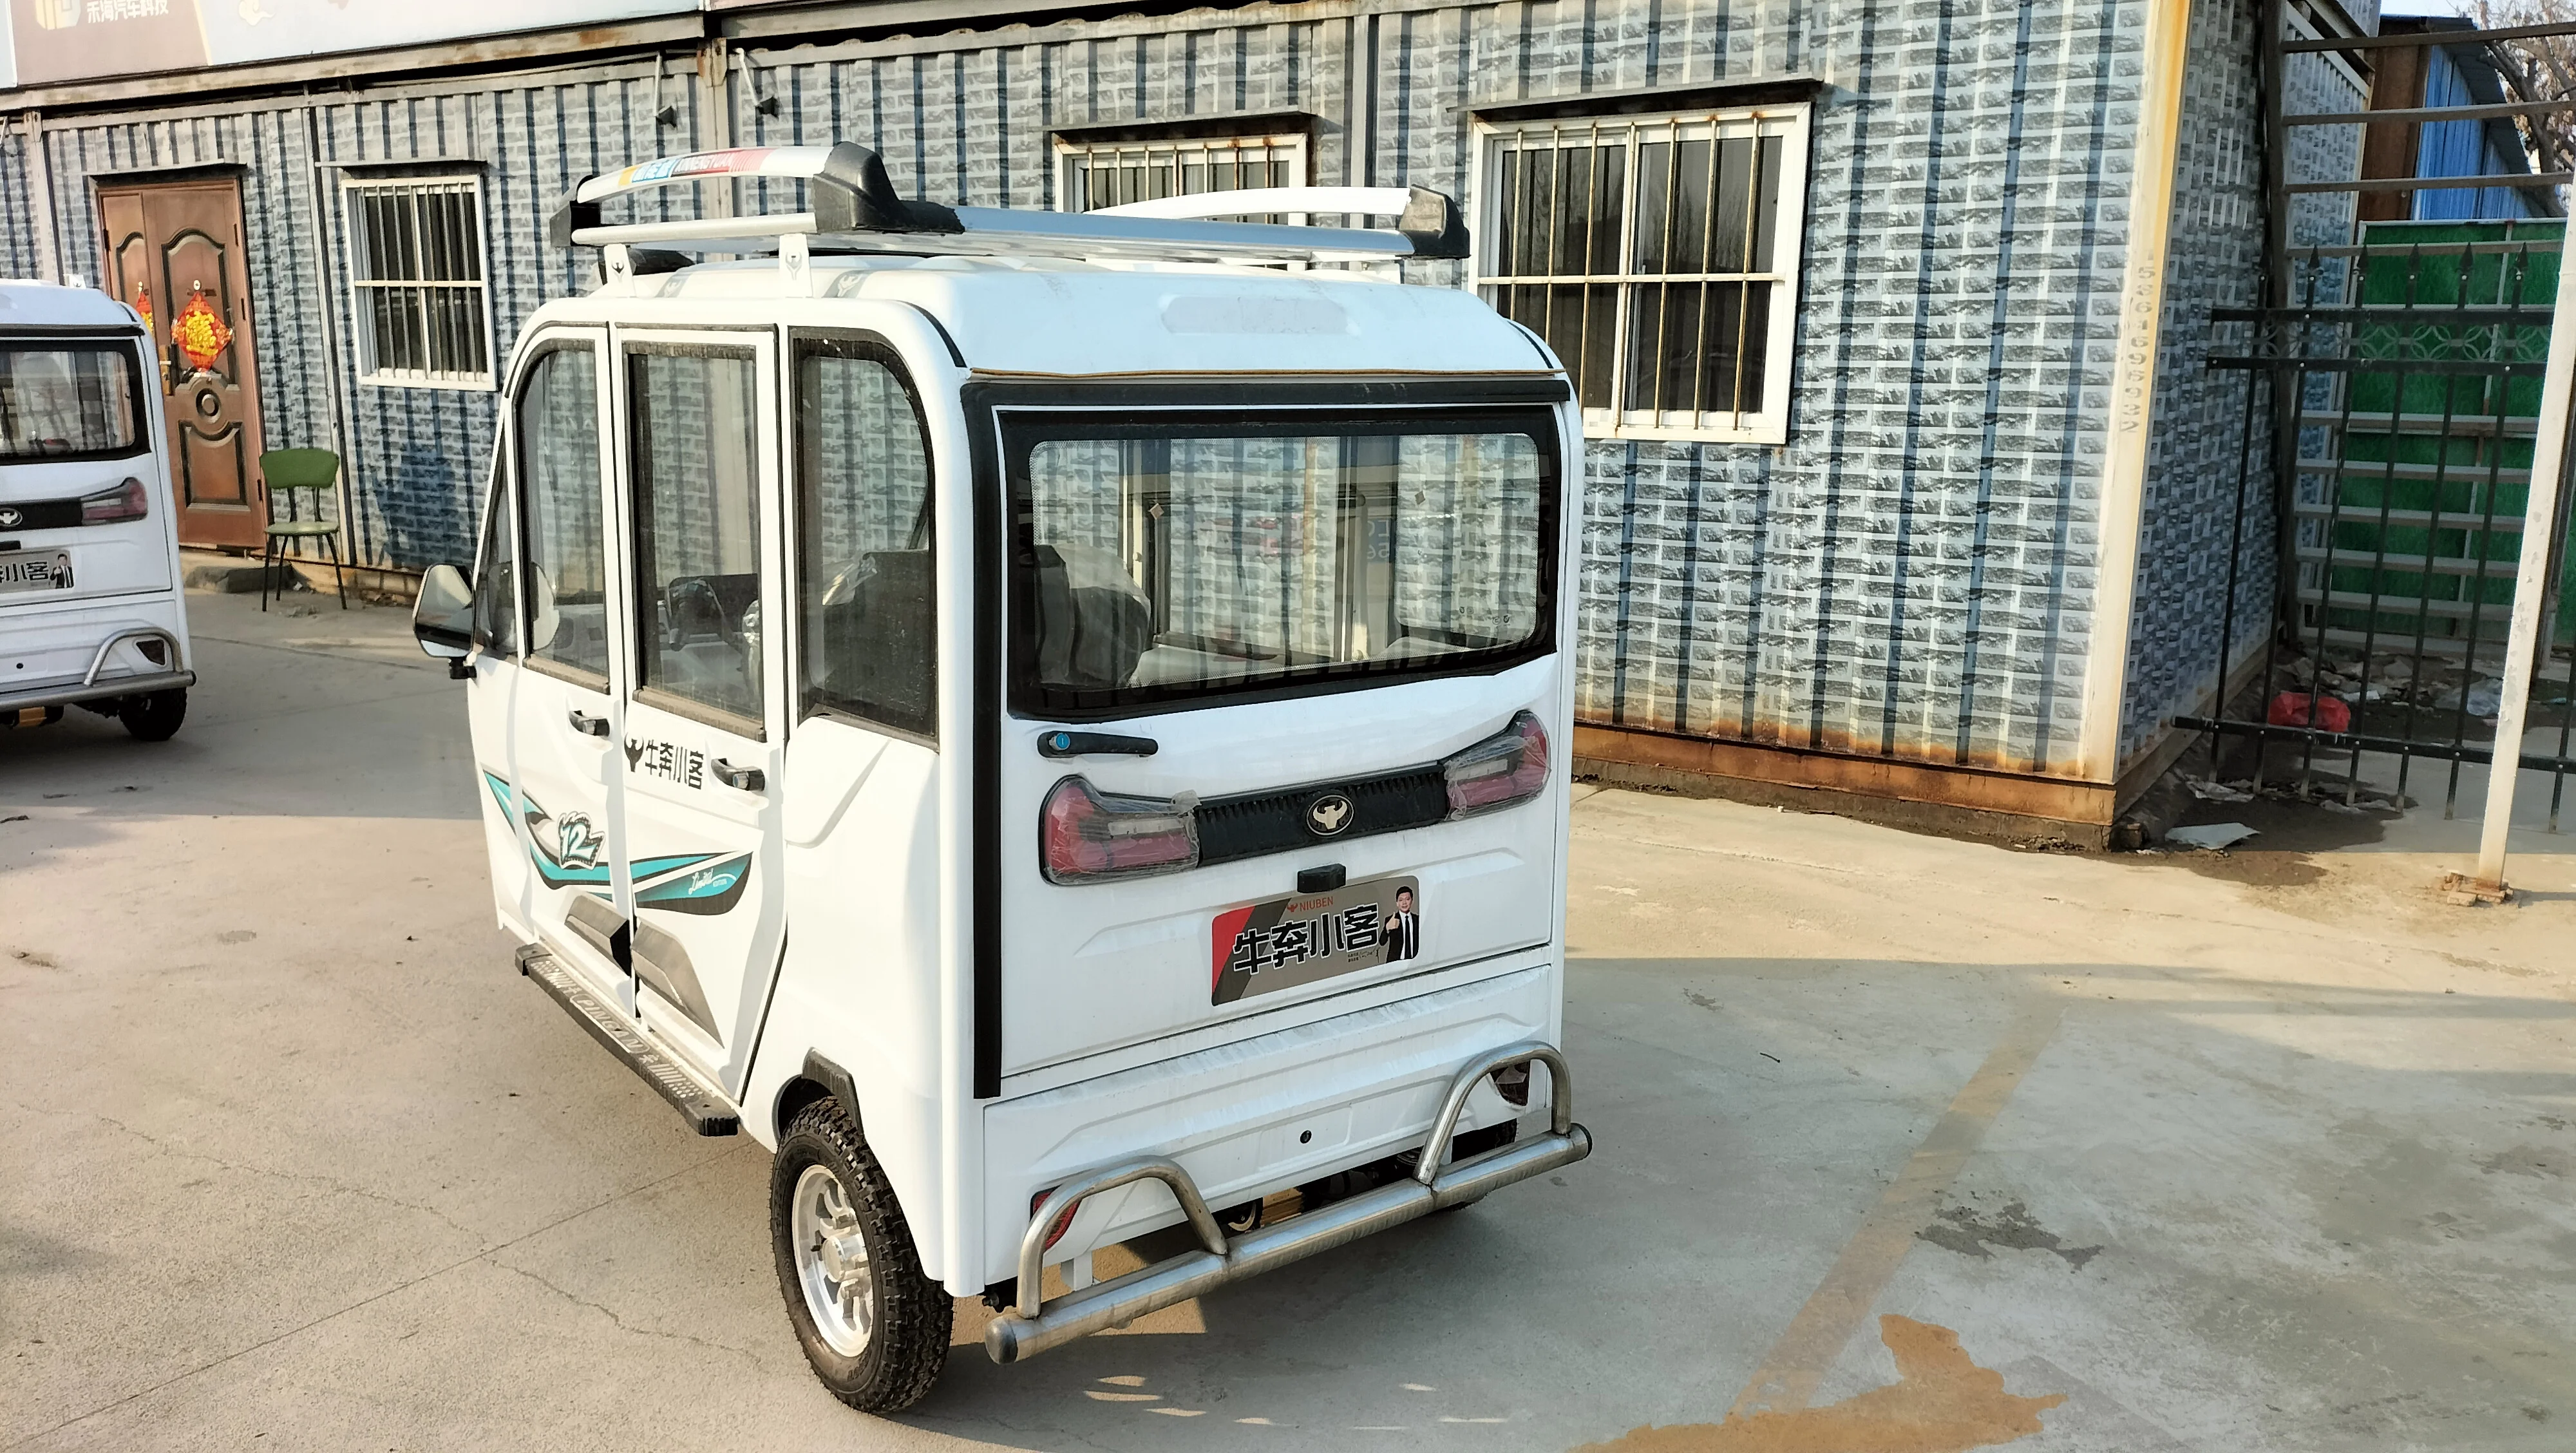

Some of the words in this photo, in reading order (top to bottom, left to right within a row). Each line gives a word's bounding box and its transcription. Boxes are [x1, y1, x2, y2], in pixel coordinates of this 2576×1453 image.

[0, 560, 49, 584] 小客
[645, 739, 704, 790] 牛奔小客
[558, 815, 603, 867] 12
[1300, 897, 1334, 911] NIUBEN
[1233, 902, 1379, 975] 牛奔小客
